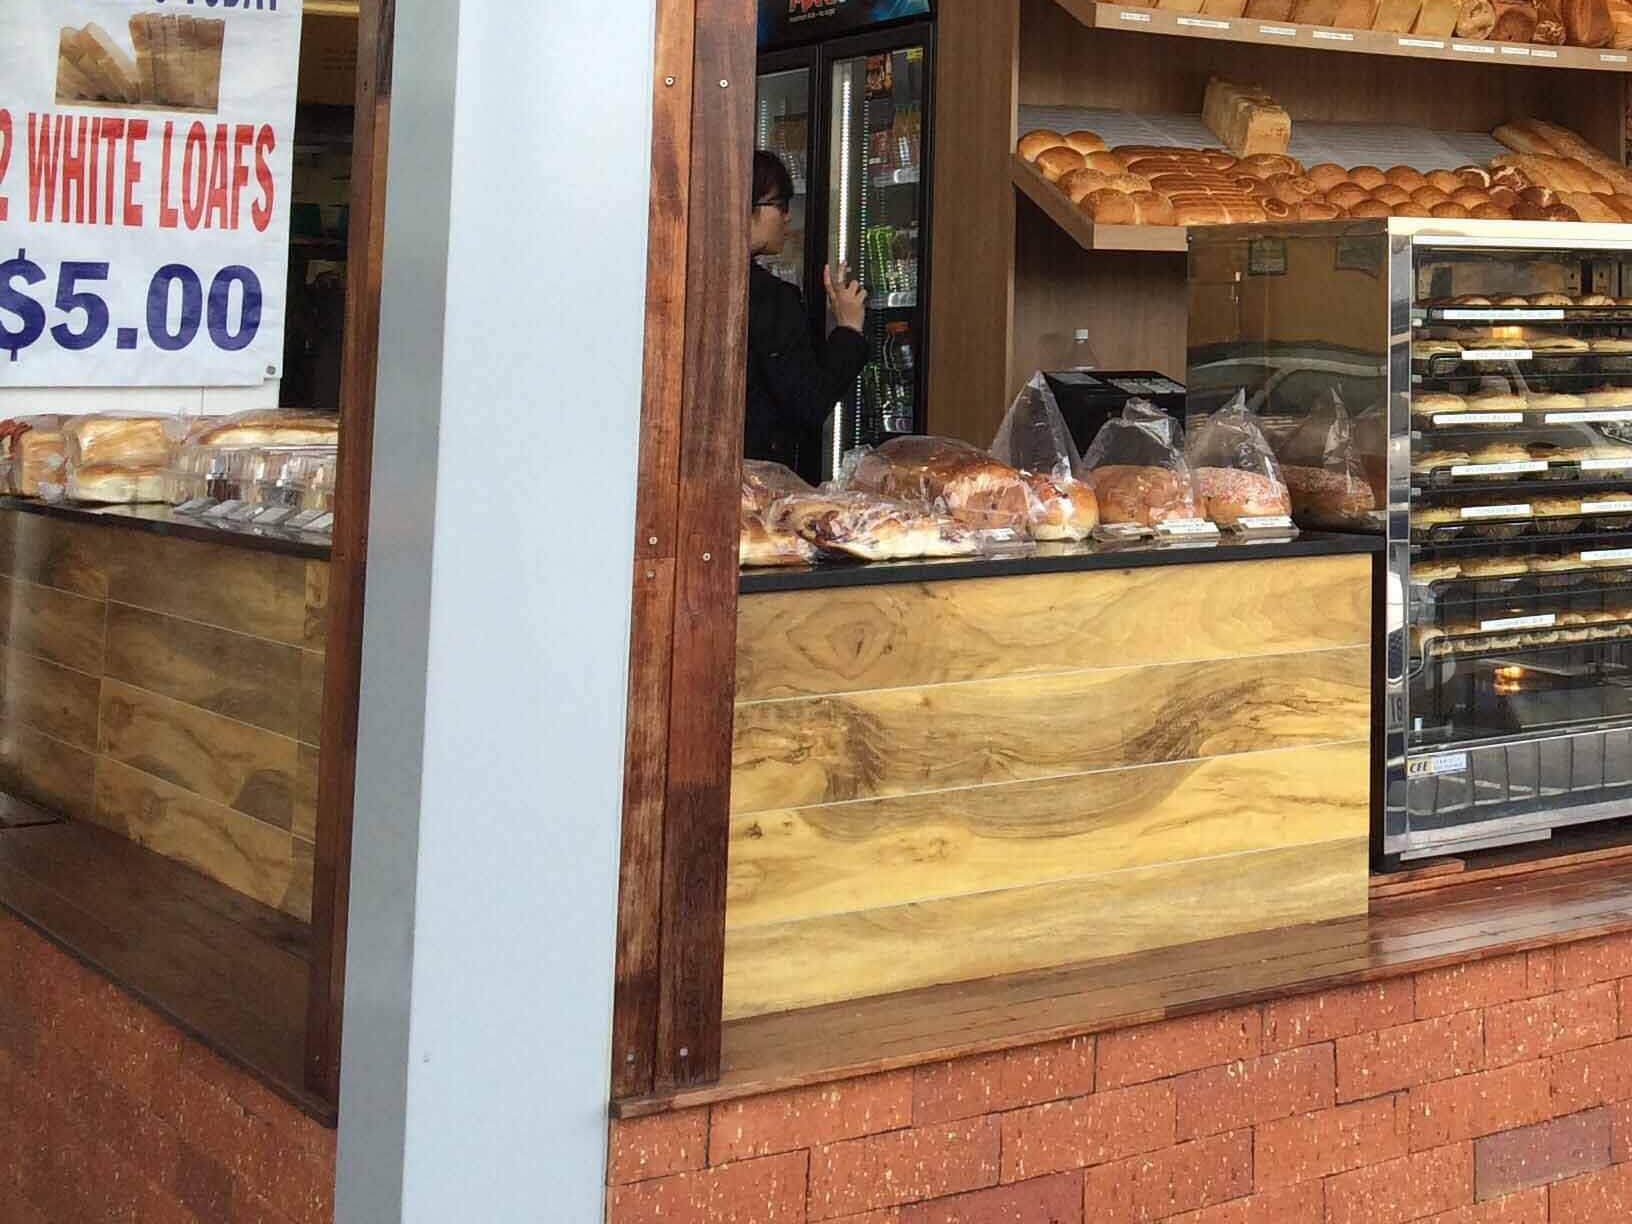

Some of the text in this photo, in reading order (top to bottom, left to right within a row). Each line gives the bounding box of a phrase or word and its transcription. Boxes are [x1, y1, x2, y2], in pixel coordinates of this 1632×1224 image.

[27, 112, 149, 227] WHITE
[159, 120, 276, 233] LOAFS
[0, 247, 263, 363] $5.00
